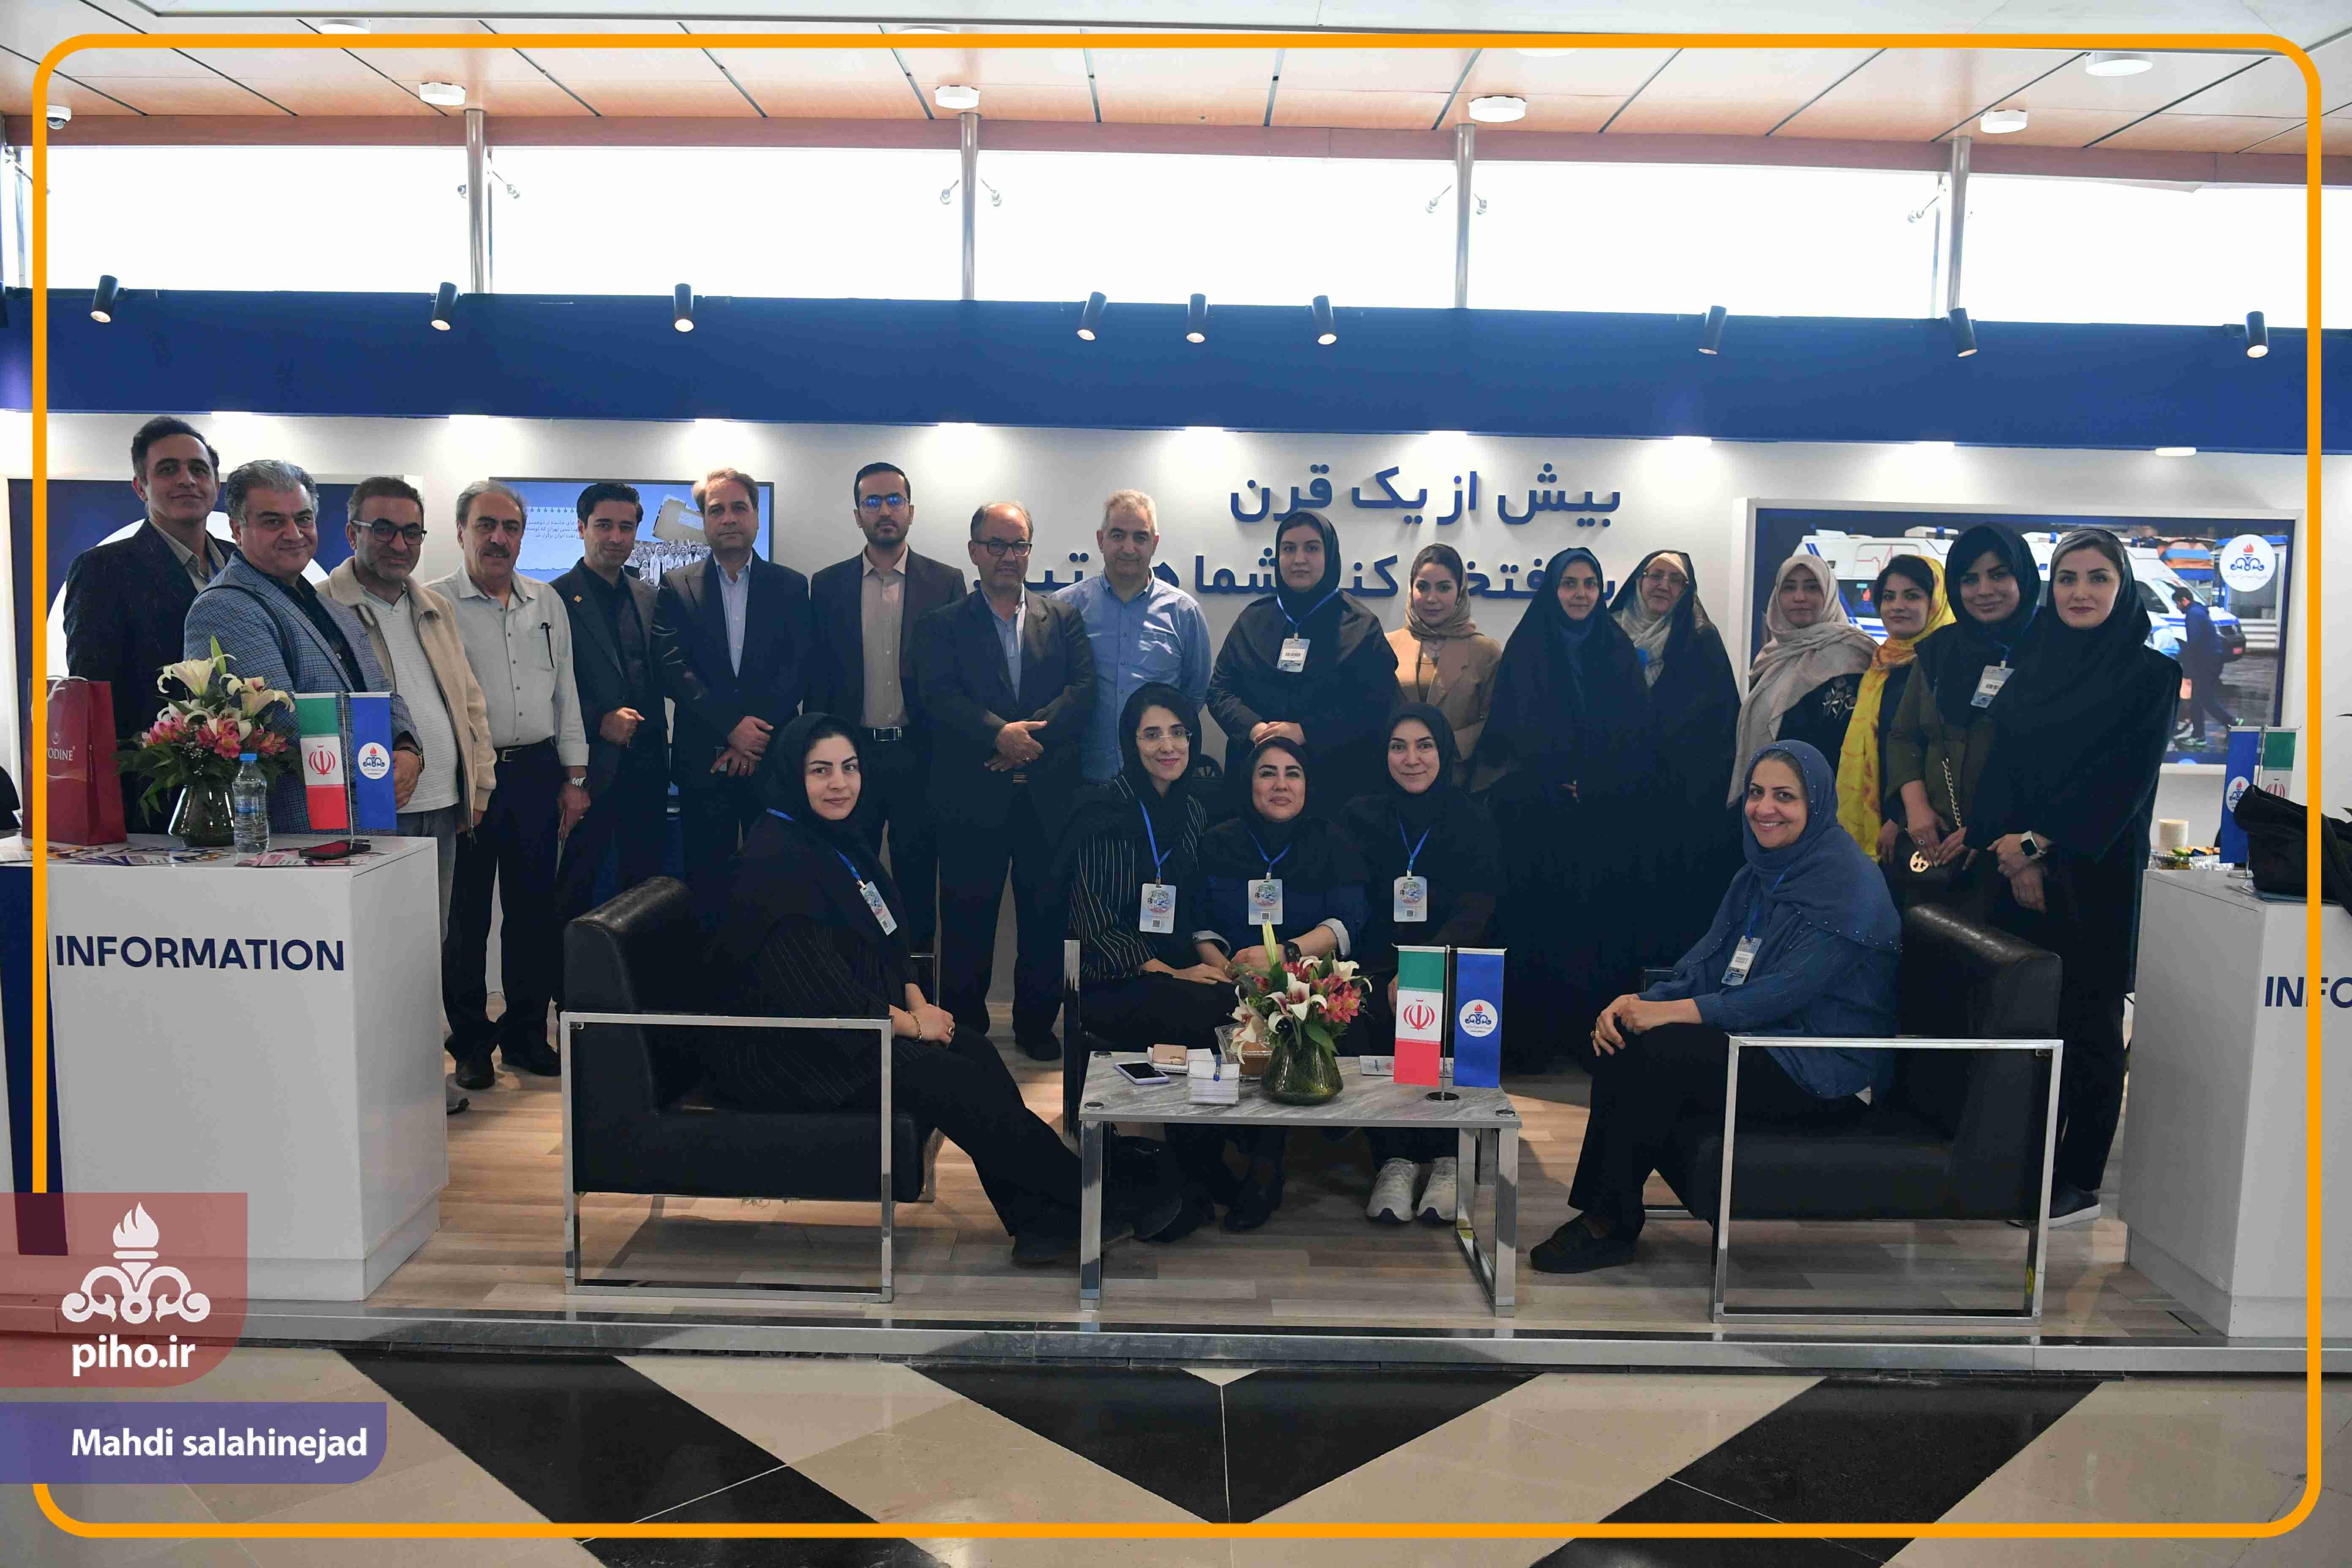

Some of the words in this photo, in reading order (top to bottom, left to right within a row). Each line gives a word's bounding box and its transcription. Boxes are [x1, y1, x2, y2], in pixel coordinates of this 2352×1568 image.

[1230, 464, 1332, 522] قرن
[1351, 466, 1427, 524] یک
[1437, 471, 1477, 525] از
[1498, 463, 1620, 527] بیش
[47, 747, 73, 761] ODINE
[55, 935, 345, 971] INFORMATION
